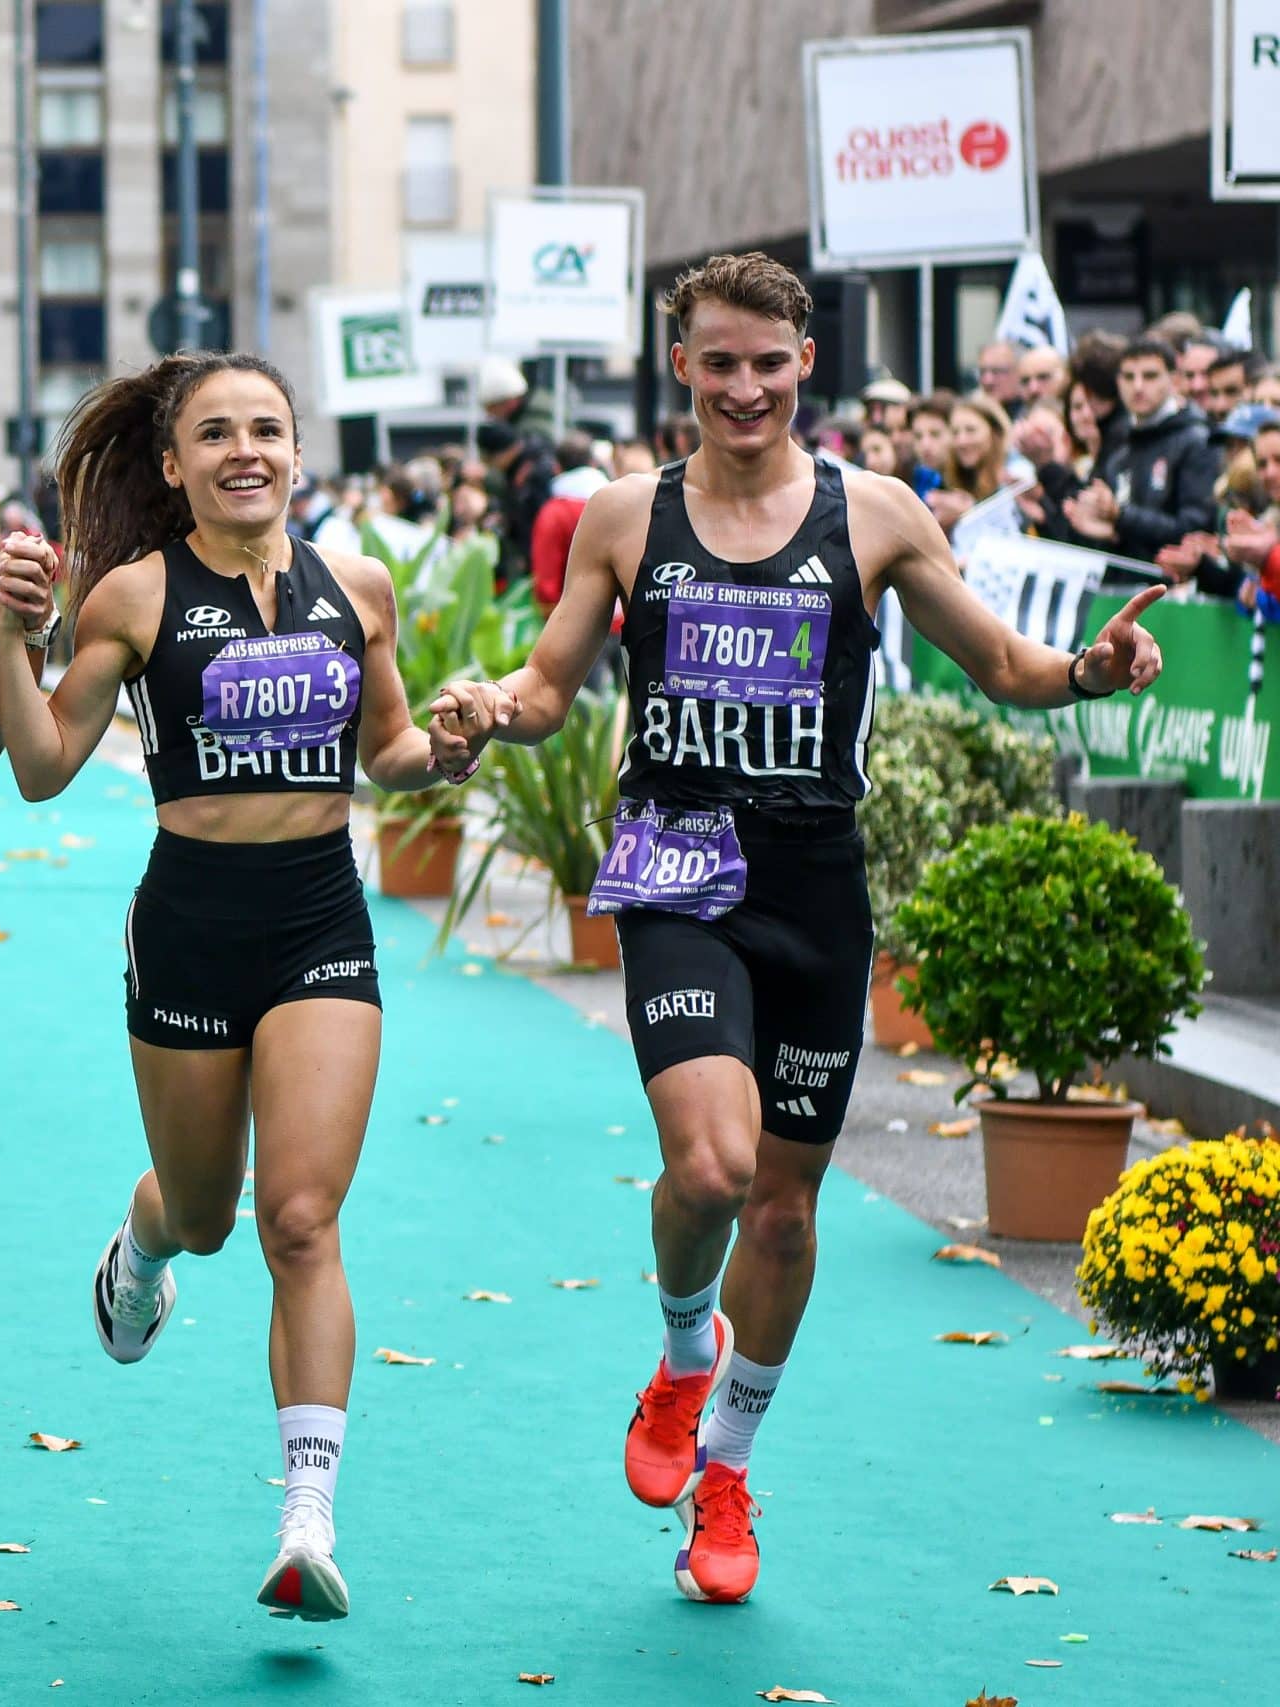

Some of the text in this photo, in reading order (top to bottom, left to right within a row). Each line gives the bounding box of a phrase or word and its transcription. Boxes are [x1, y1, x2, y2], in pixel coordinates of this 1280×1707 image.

[675, 585, 826, 609] RELAIS ENTREPRISES 2025
[177, 627, 247, 642] HYUNDAI
[248, 636, 320, 656] ENTREPRISES
[679, 620, 813, 670] R7807-4
[220, 660, 349, 720] R7807-3
[643, 697, 824, 778] BARTH
[645, 993, 715, 1025] BARTH
[778, 1043, 850, 1068] RUNNING
[288, 1436, 340, 1458] RUNNING
